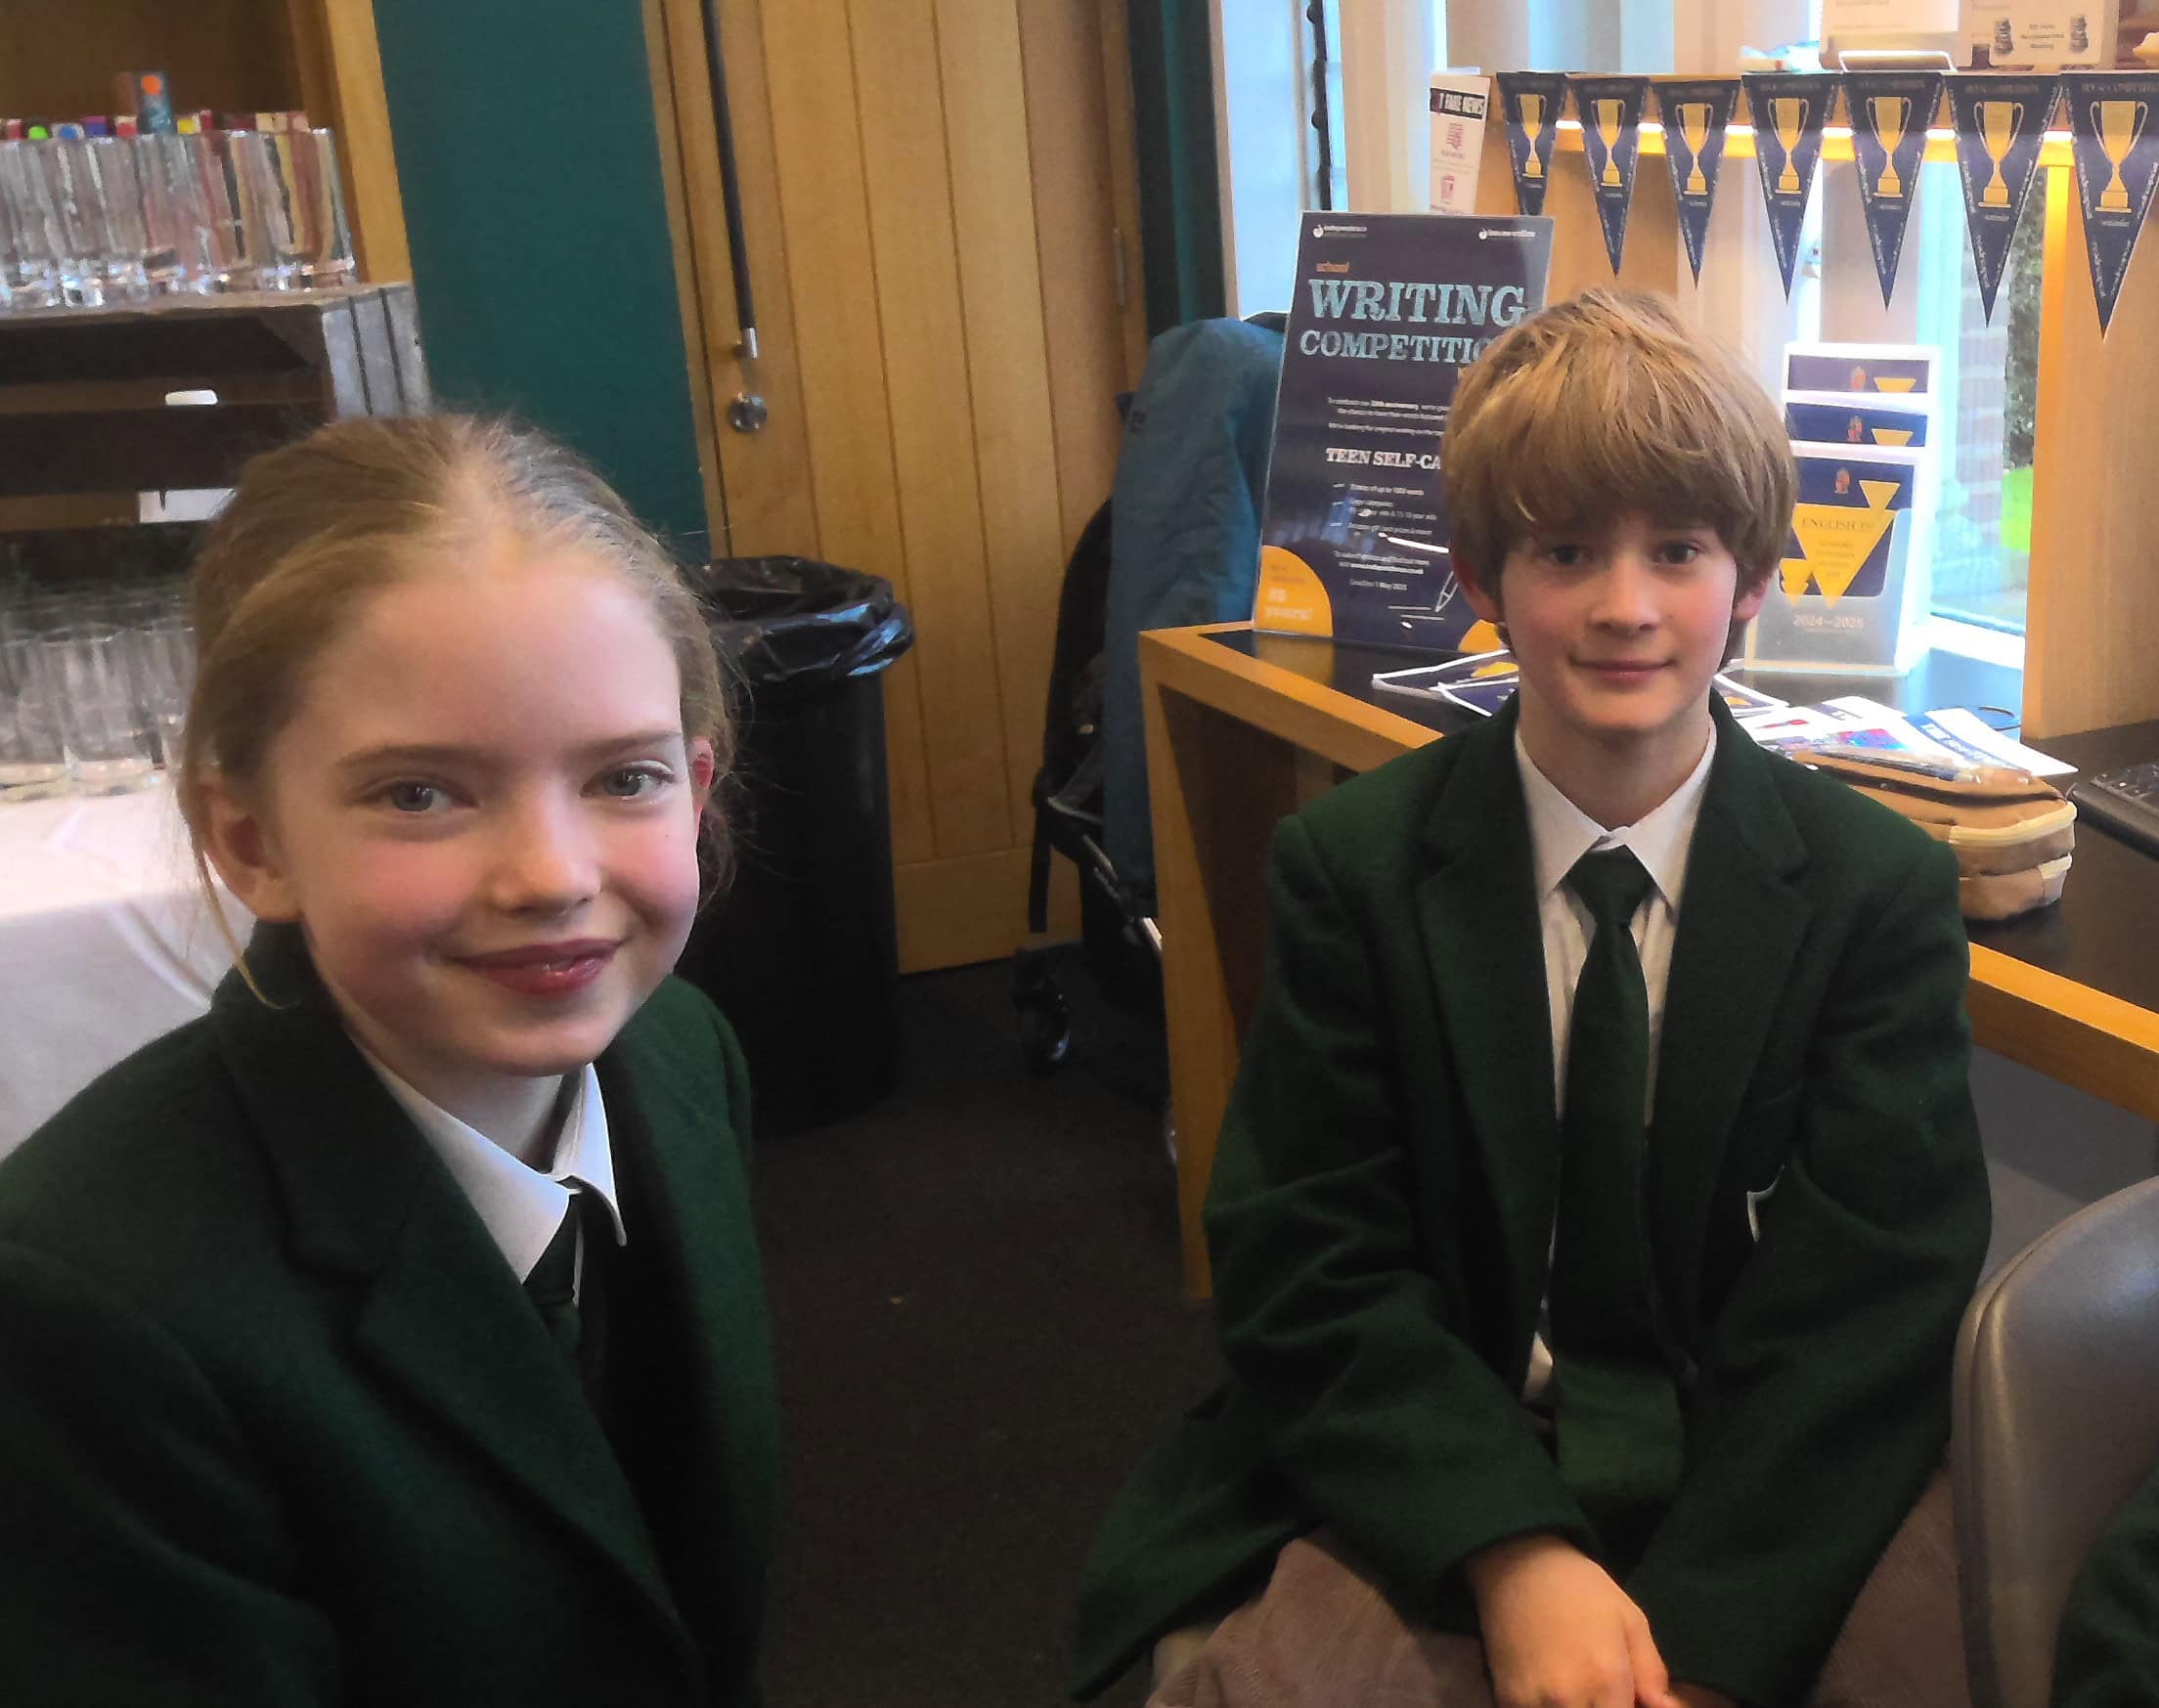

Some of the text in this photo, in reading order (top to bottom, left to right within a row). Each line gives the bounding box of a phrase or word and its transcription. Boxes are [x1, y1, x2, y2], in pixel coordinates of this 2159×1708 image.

[1307, 279, 1527, 328] WRITING
[1325, 447, 1441, 470] TEEN SELF-CA
